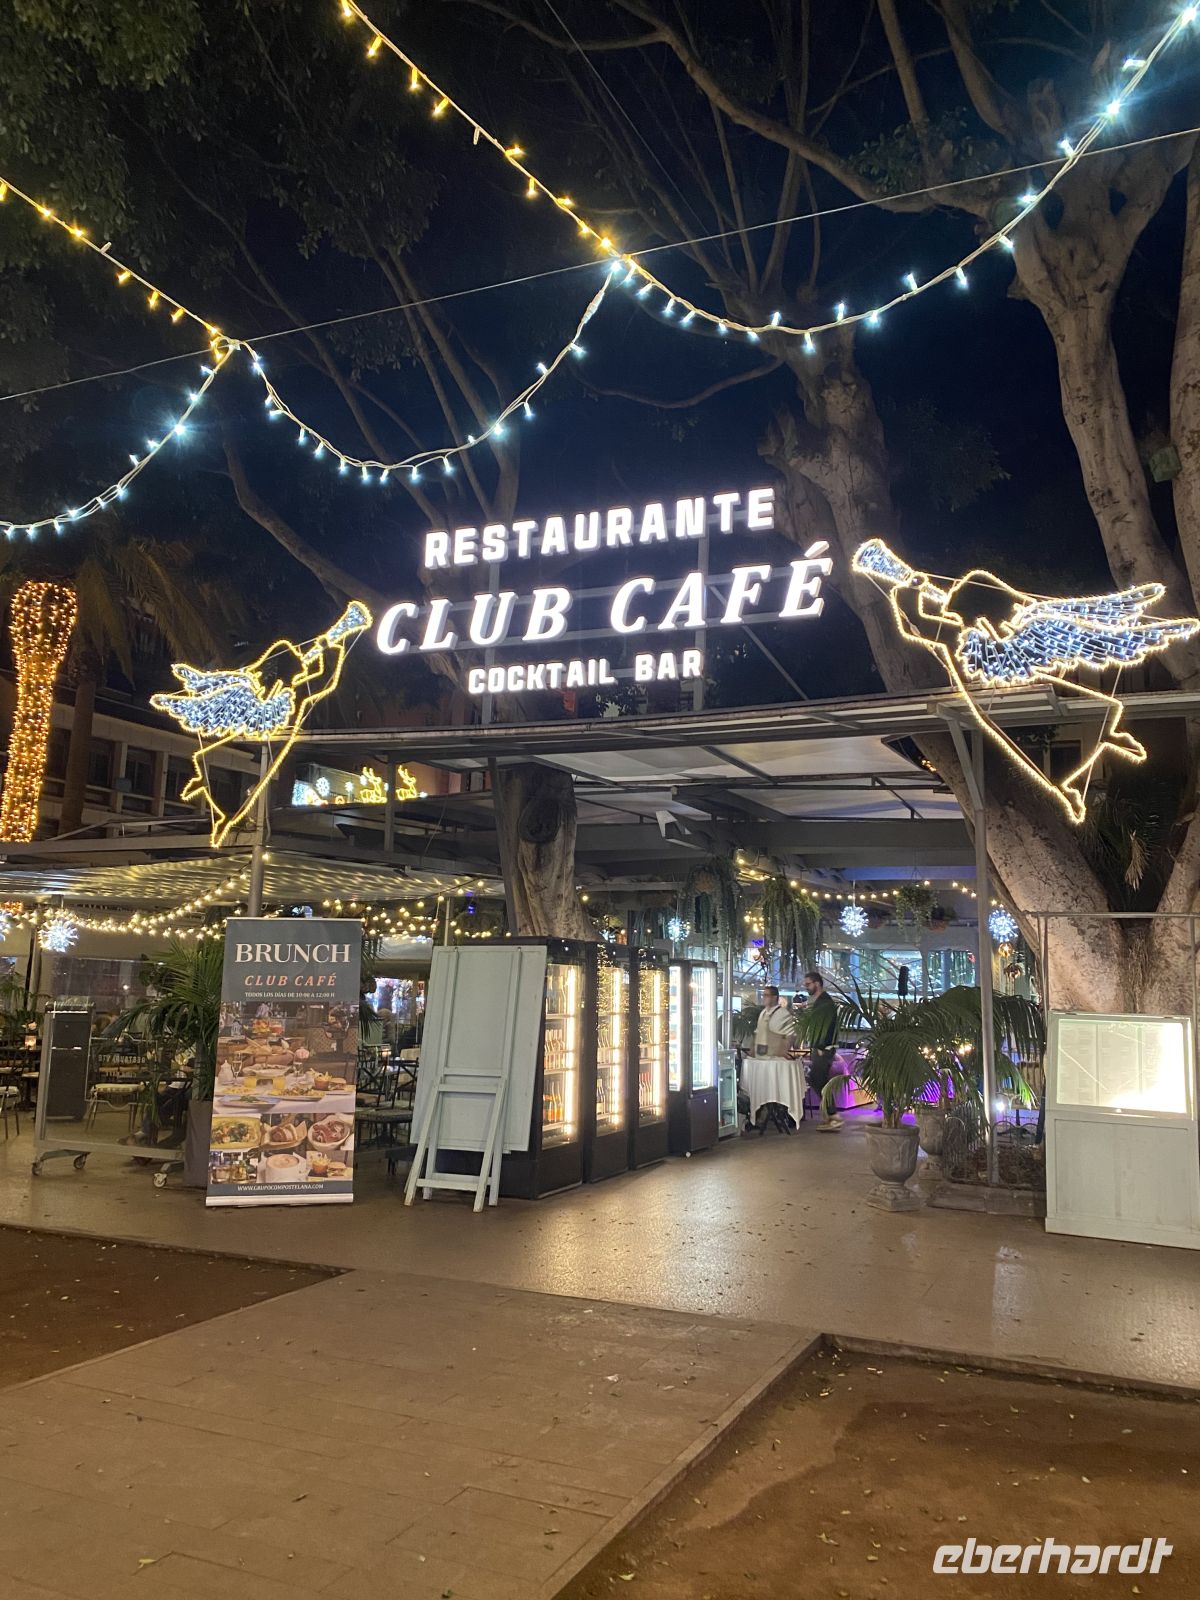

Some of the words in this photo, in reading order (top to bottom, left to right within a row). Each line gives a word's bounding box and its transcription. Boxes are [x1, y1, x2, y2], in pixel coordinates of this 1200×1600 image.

[424, 487, 775, 570] RESTAURANTE
[375, 585, 573, 656] CLUB
[609, 540, 834, 634] CAFÉ
[467, 656, 616, 695] COCKTAIL
[634, 649, 702, 682] BAR
[234, 943, 351, 963] BRUNCH
[244, 975, 288, 987] CLUB
[294, 972, 337, 987] CAFÉ
[237, 1184, 324, 1192] WWW.GRUPOCOMPOSTELANA.COM
